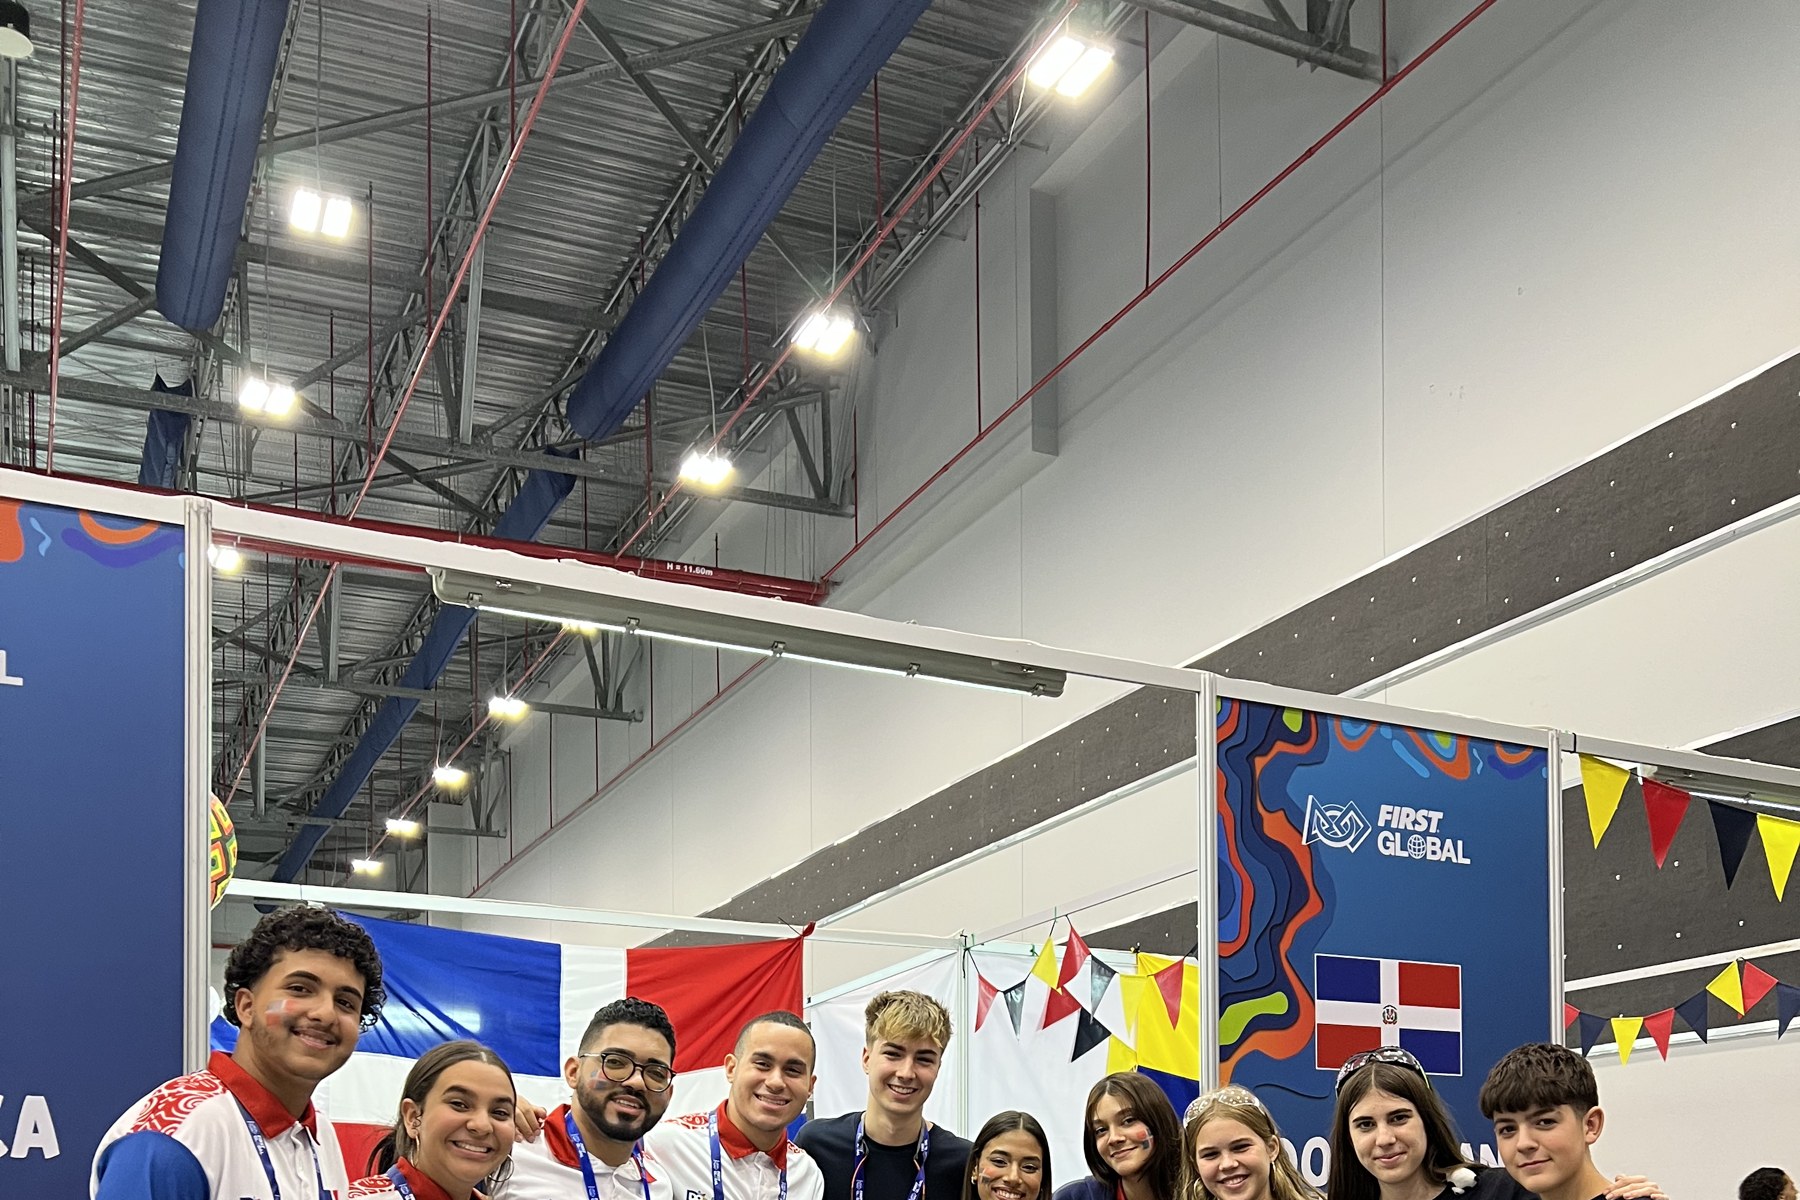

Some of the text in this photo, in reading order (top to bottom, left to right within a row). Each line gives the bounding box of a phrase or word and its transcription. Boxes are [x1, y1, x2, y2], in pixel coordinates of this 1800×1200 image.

[666, 562, 674, 570] H
[683, 565, 713, 576] 11.60m
[1377, 804, 1444, 834] FIRST
[1377, 830, 1471, 865] GLOBAL
